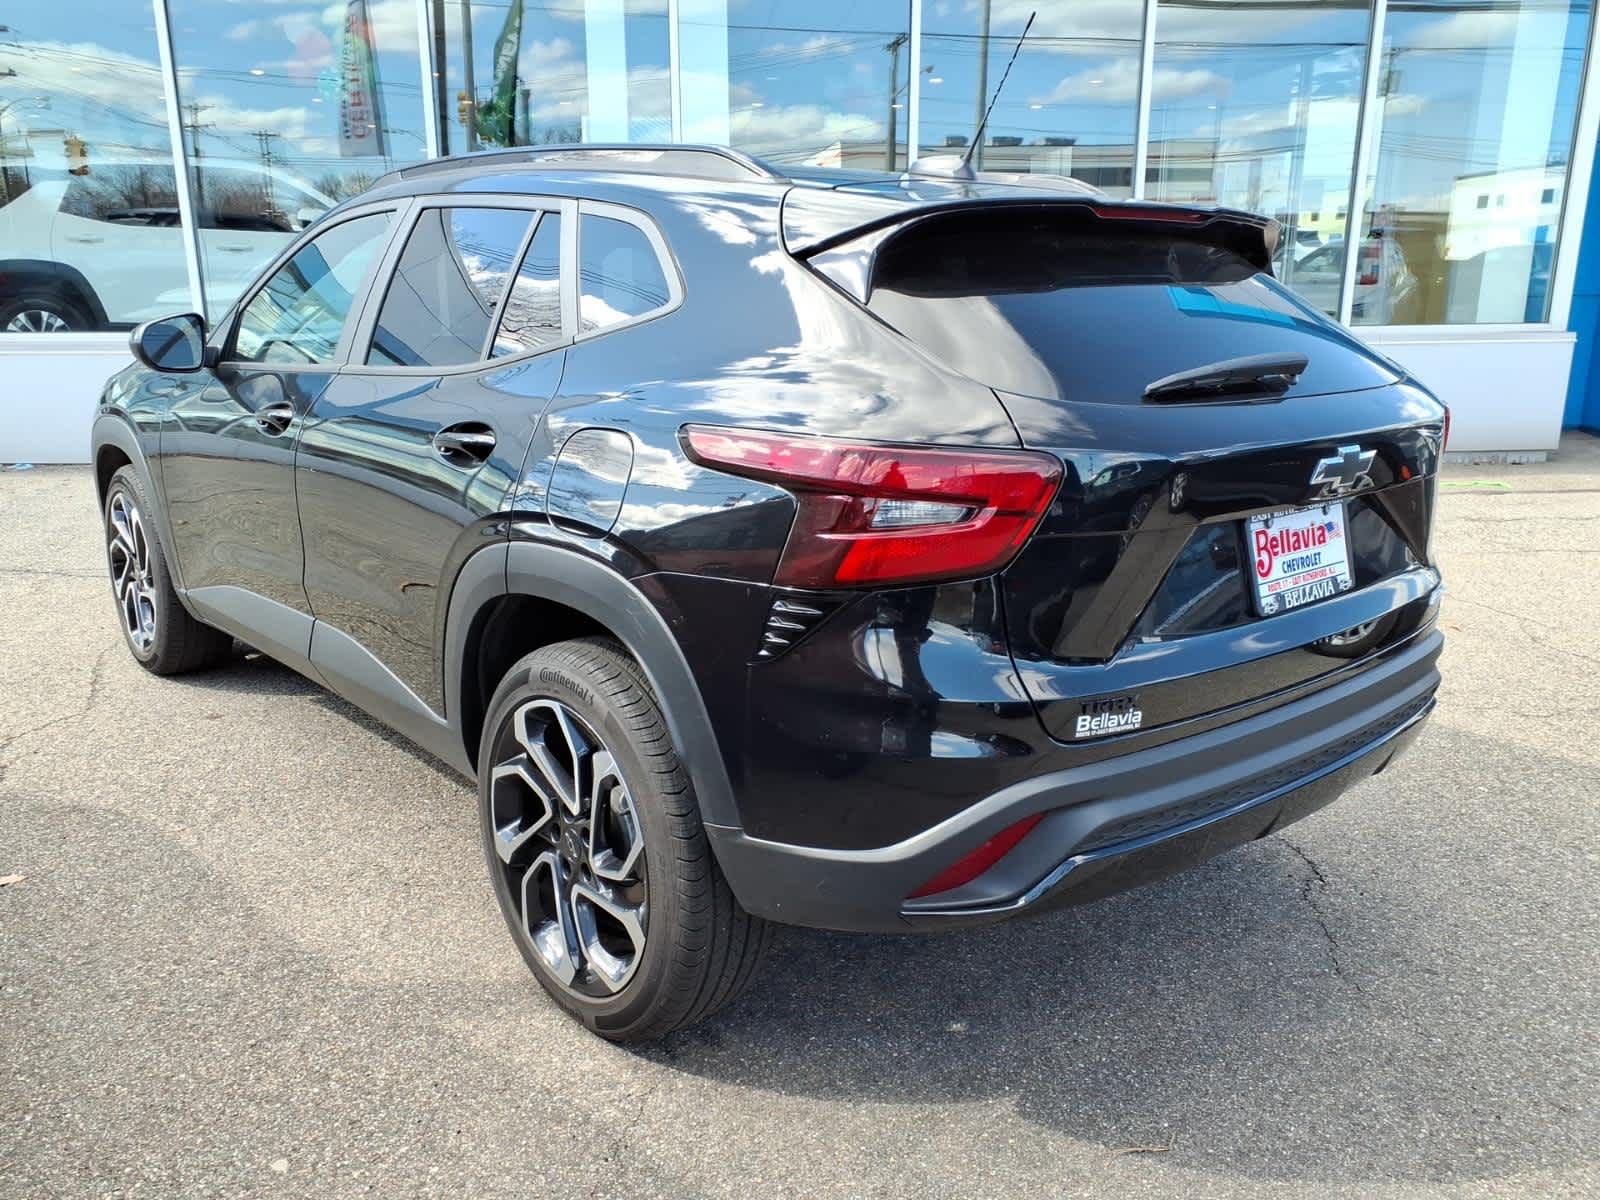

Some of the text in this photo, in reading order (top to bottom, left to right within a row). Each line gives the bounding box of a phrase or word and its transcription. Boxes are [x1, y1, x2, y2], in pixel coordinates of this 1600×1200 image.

[1255, 523, 1327, 577] Bellavia
[1281, 551, 1322, 574] CHEVROLET
[1284, 581, 1335, 608] BELLAVIA
[540, 666, 589, 701] Continental
[1076, 707, 1142, 732] Bellavia
